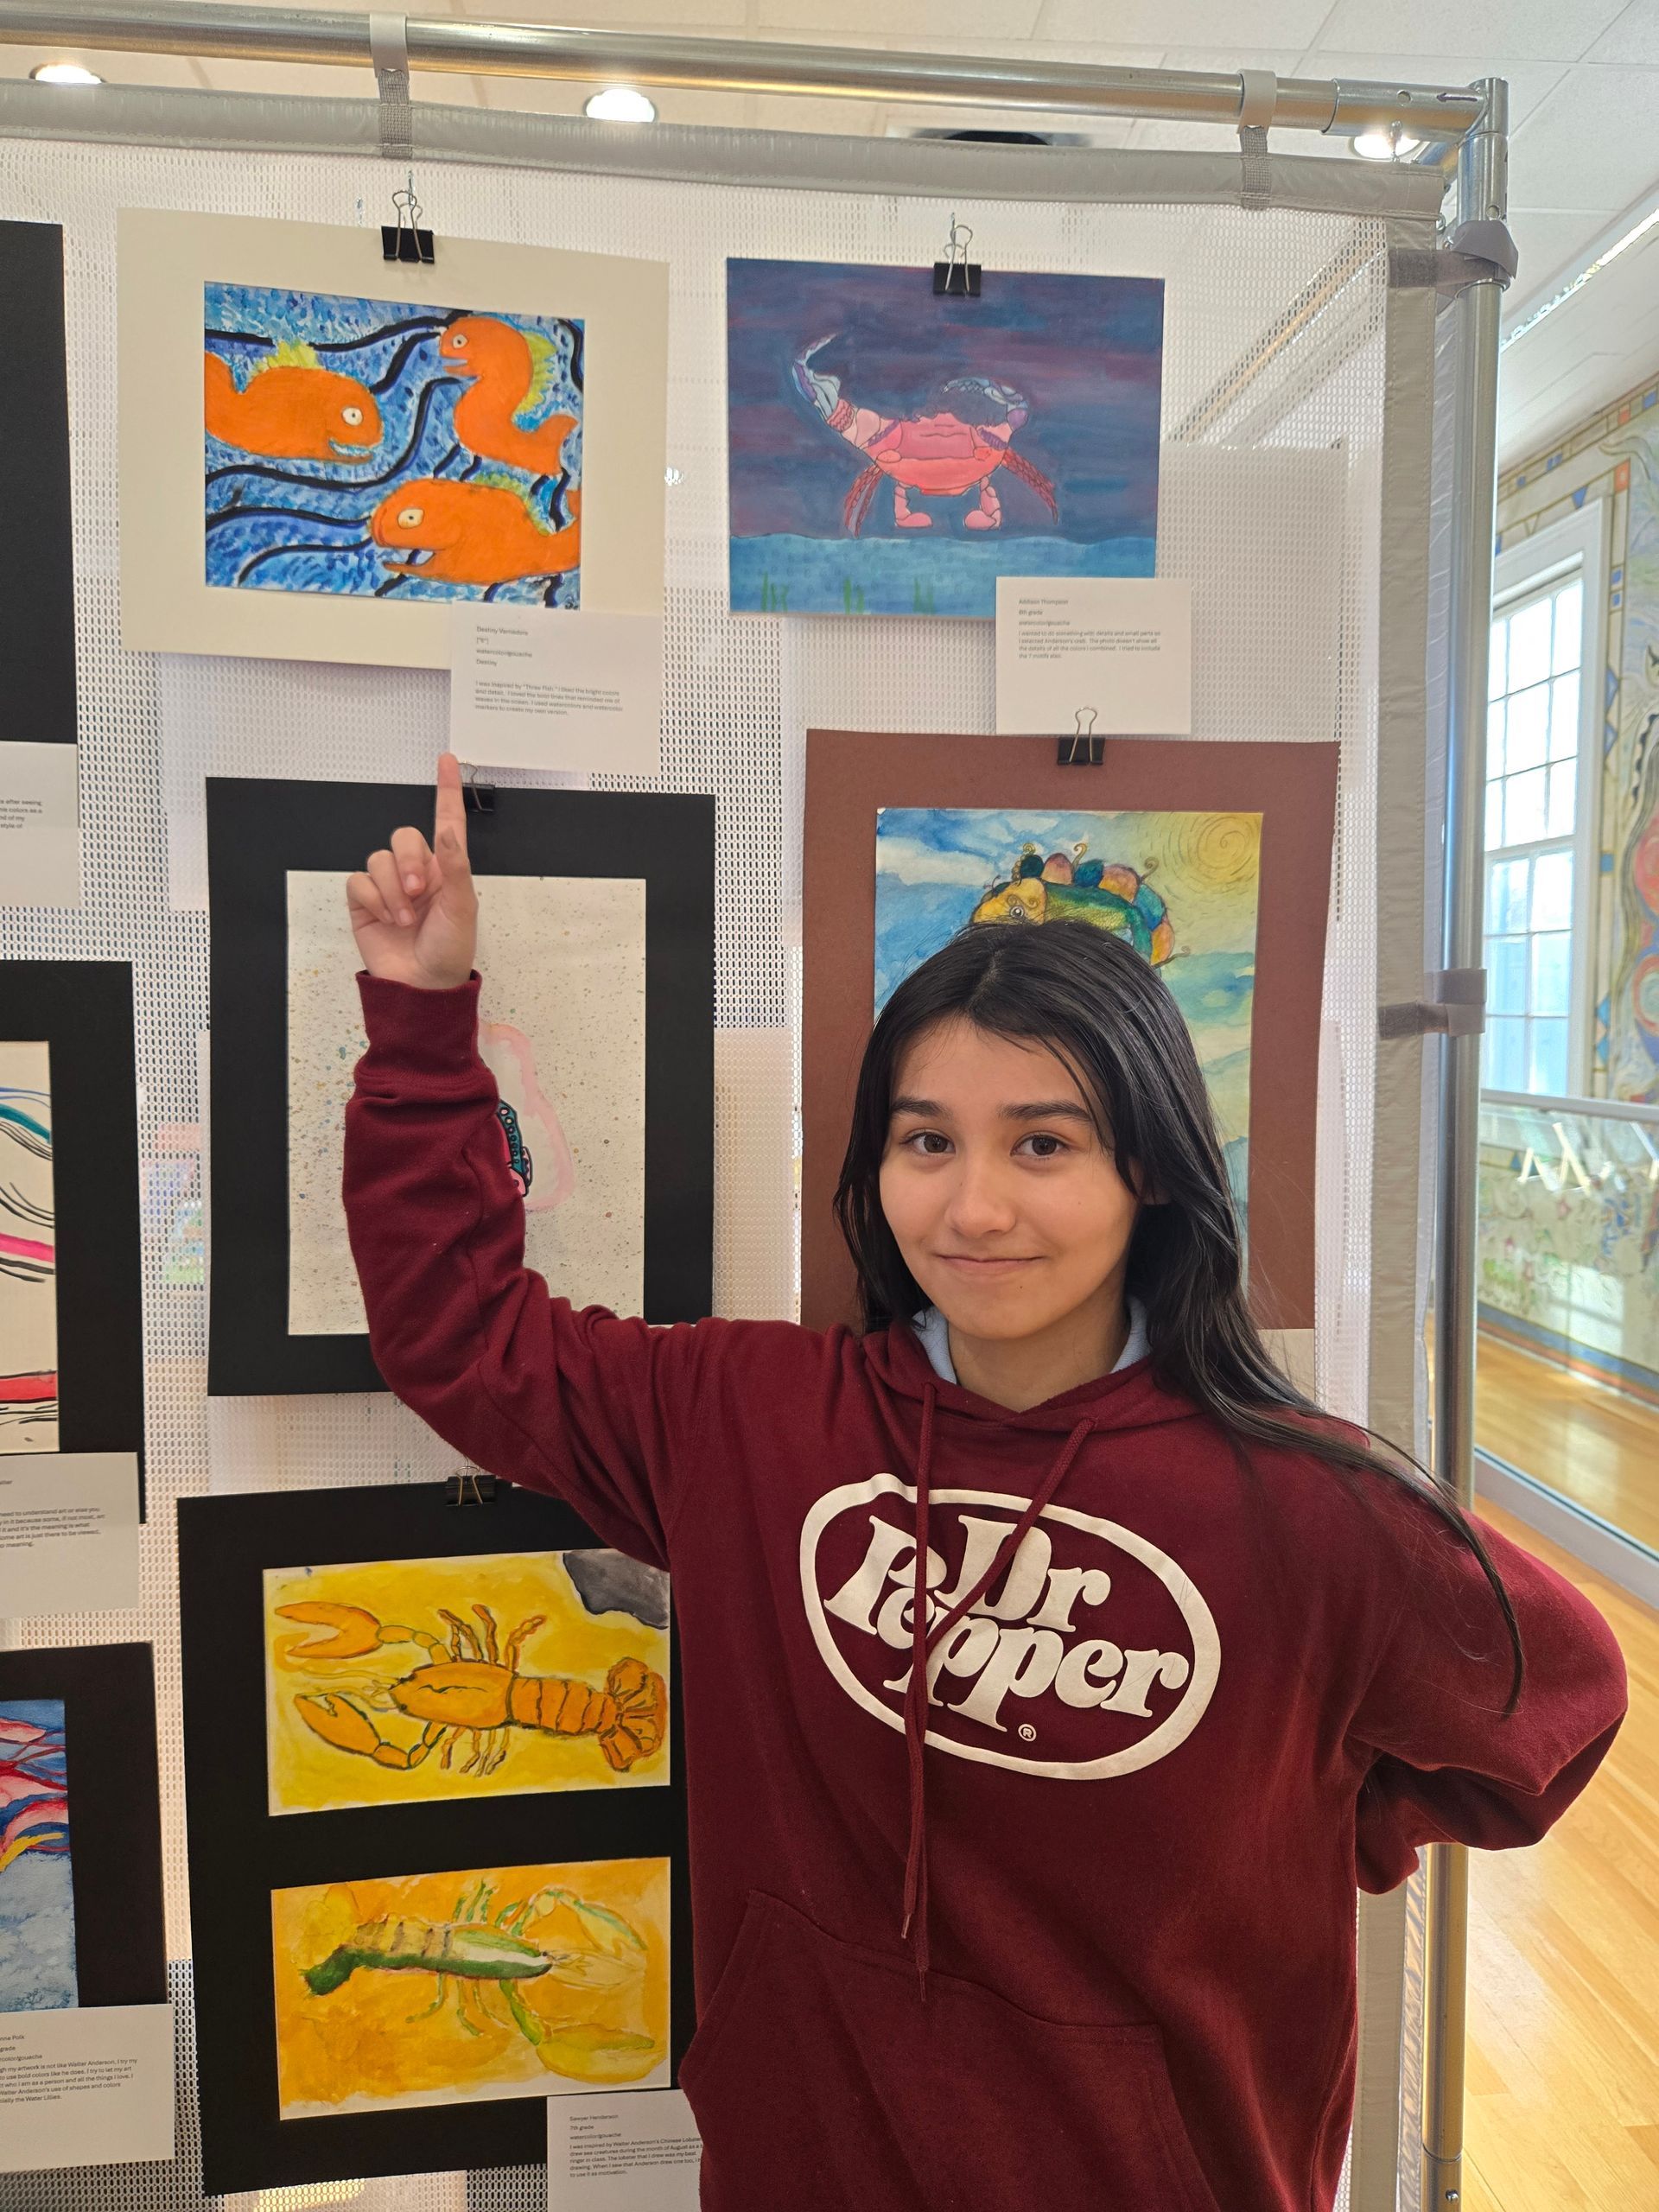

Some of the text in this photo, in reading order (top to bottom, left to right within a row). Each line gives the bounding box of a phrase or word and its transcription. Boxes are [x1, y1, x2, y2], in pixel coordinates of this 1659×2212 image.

[491, 682, 514, 690] inspired
[823, 1515, 1190, 1733] Pepper
[933, 1514, 1111, 1632] Dr
